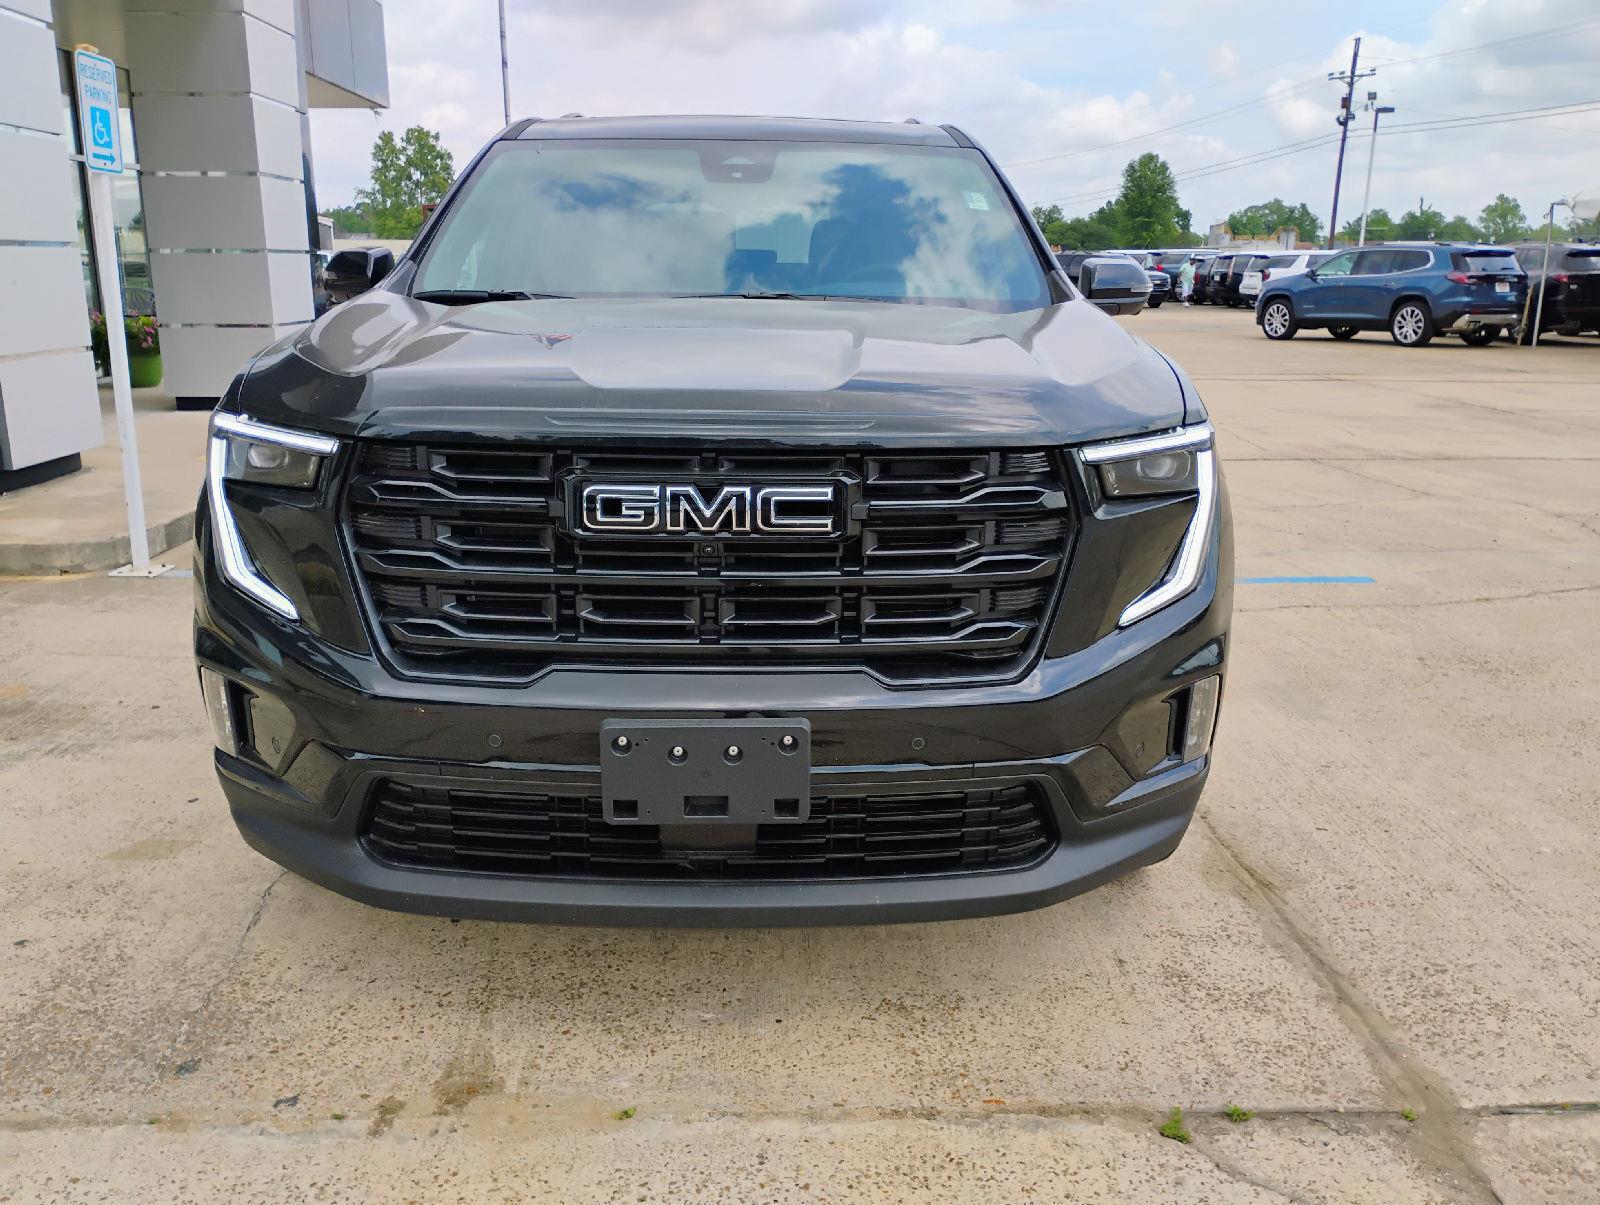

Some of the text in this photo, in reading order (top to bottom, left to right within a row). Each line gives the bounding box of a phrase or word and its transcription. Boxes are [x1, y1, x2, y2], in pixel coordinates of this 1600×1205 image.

[79, 63, 113, 85] RESERVED
[84, 84, 112, 104] PARKING
[582, 484, 835, 533] GMC
